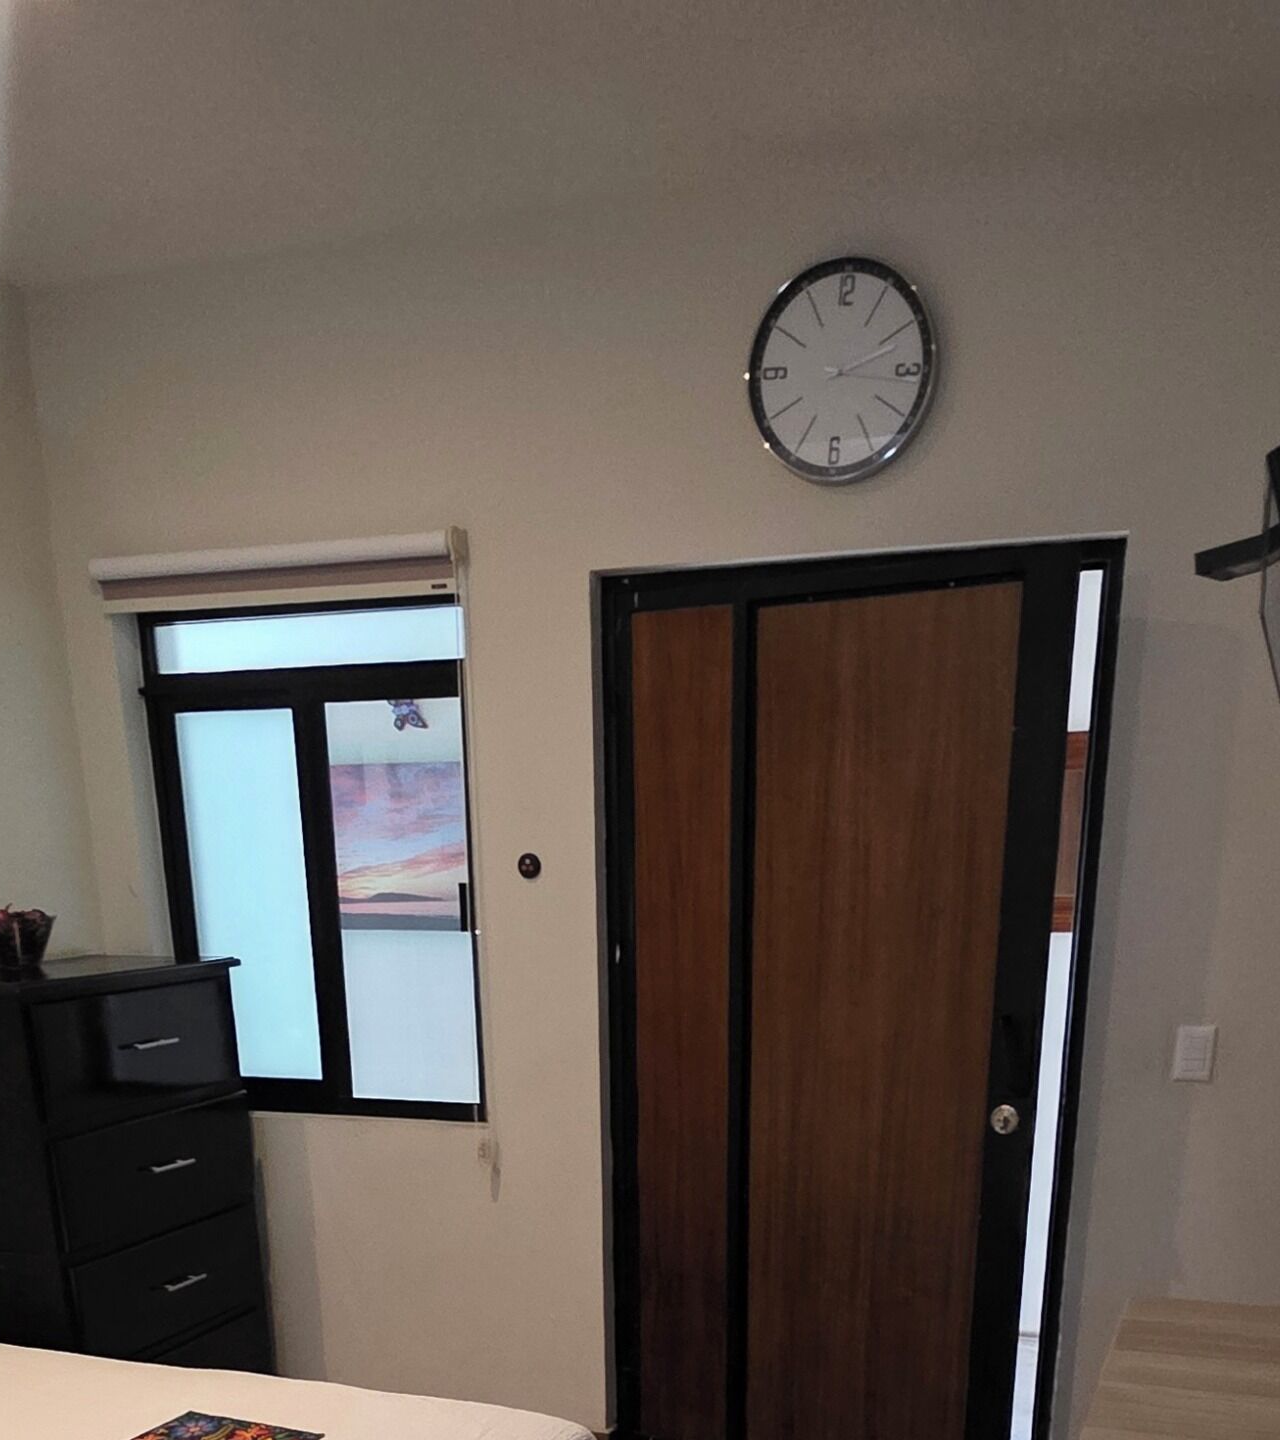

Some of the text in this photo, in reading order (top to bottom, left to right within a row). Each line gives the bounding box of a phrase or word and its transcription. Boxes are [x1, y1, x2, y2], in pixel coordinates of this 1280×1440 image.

[838, 274, 856, 307] 12
[895, 362, 920, 378] 3
[827, 436, 841, 465] 6
